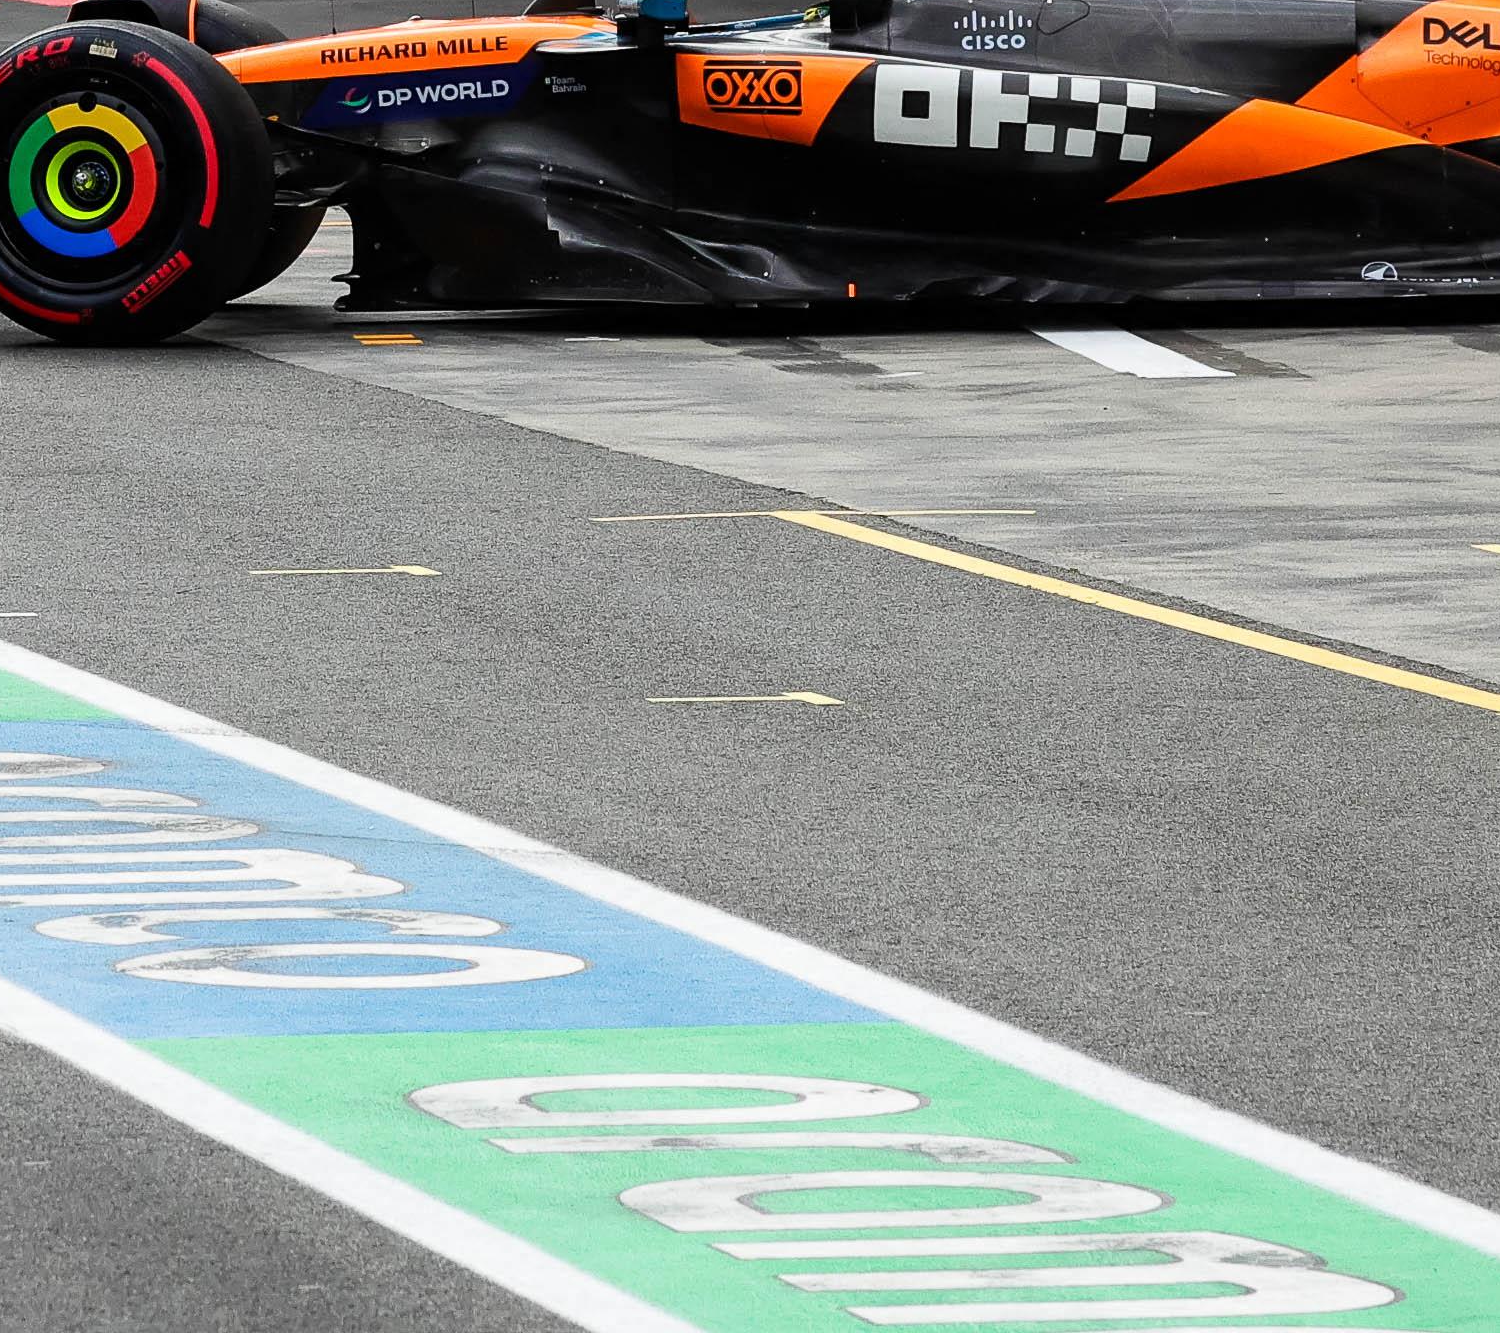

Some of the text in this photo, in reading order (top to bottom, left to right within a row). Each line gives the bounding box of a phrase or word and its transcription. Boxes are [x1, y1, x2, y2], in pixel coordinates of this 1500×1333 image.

[321, 34, 510, 67] RICHARD MILLE
[378, 79, 511, 109] DP WORLD
[551, 75, 576, 85] Team
[552, 83, 587, 93] Bahrain
[707, 71, 799, 107] OXXO
